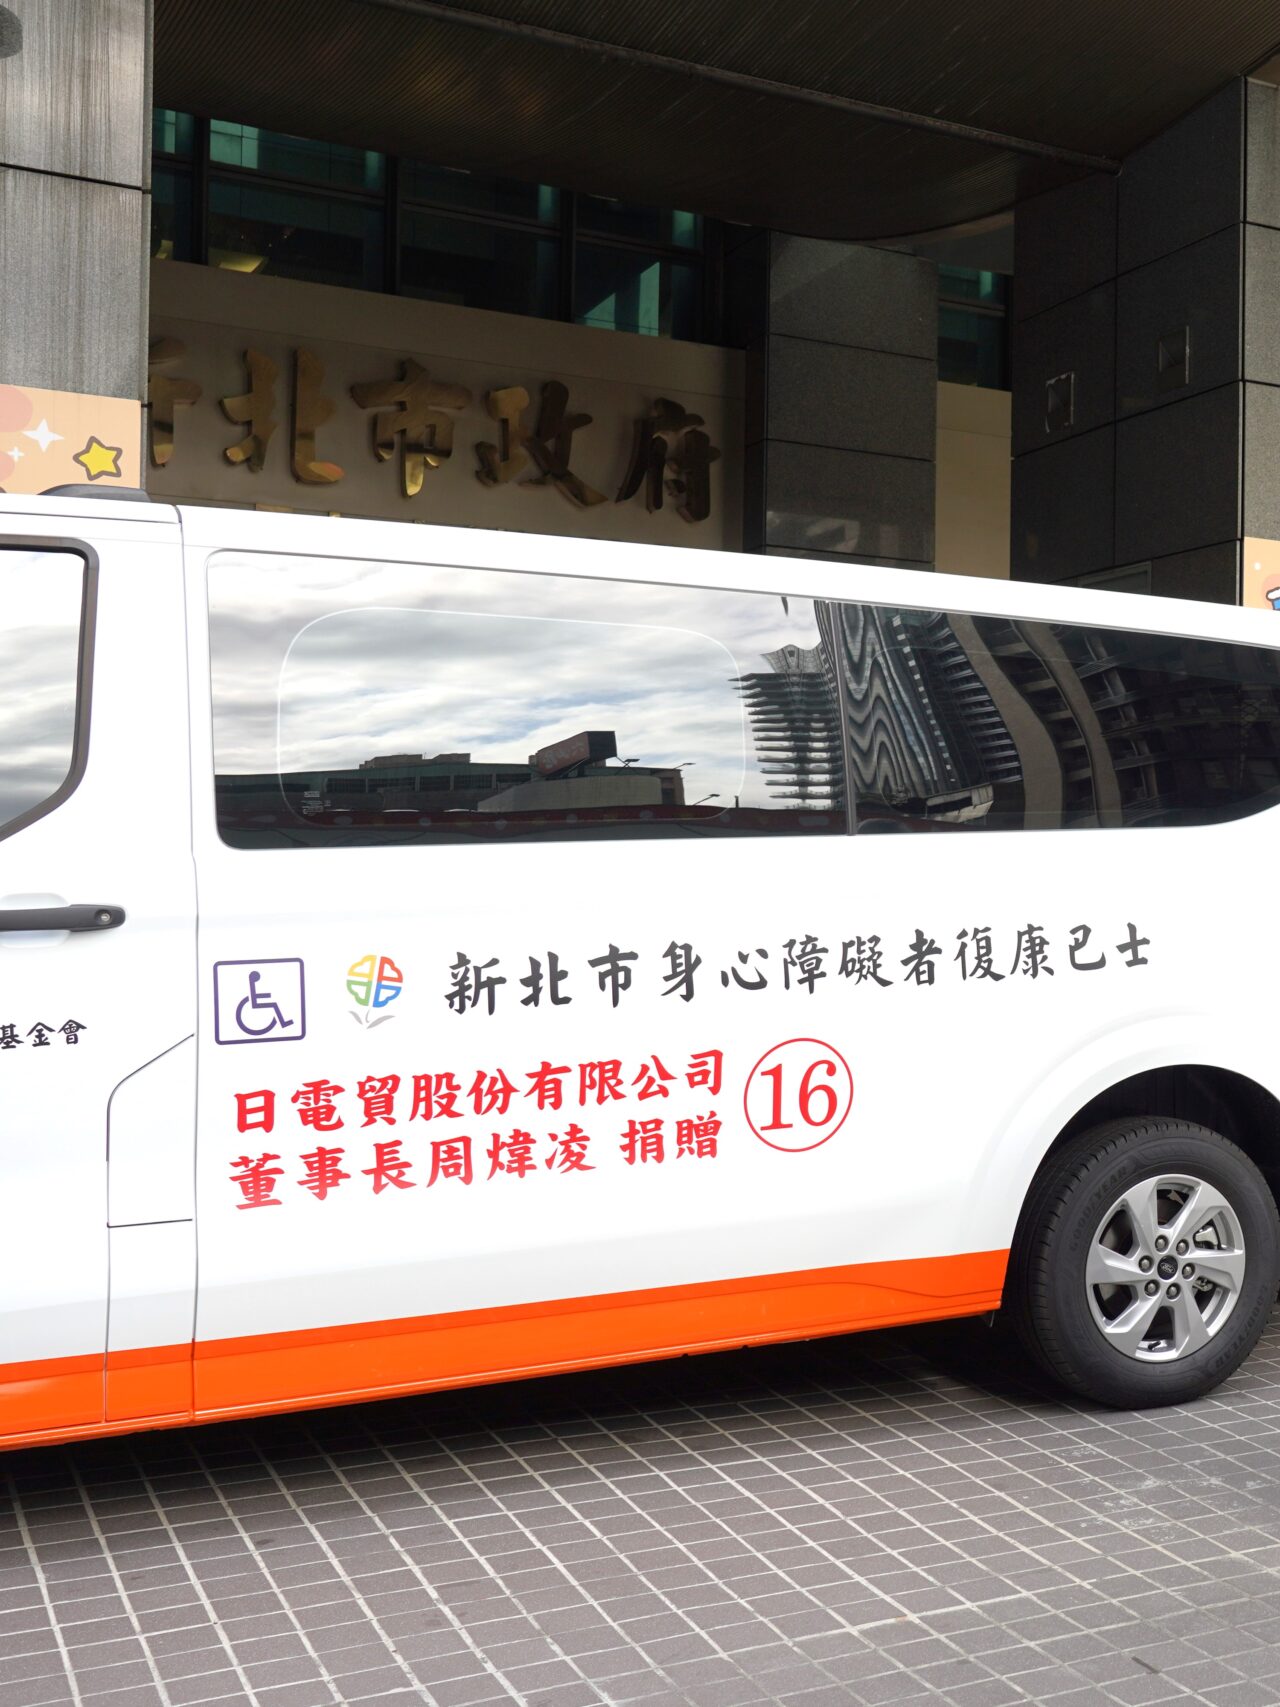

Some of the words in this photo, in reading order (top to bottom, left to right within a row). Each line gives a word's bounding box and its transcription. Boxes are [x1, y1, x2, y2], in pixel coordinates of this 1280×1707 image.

[445, 922, 1151, 1016] 新北市身心障礙者復康巴士
[0, 1019, 88, 1050] 基金會
[234, 1049, 724, 1134] 日電貿股份有限公司
[229, 1123, 597, 1210] 董事長周煒凌
[619, 1110, 723, 1166] 捐贈
